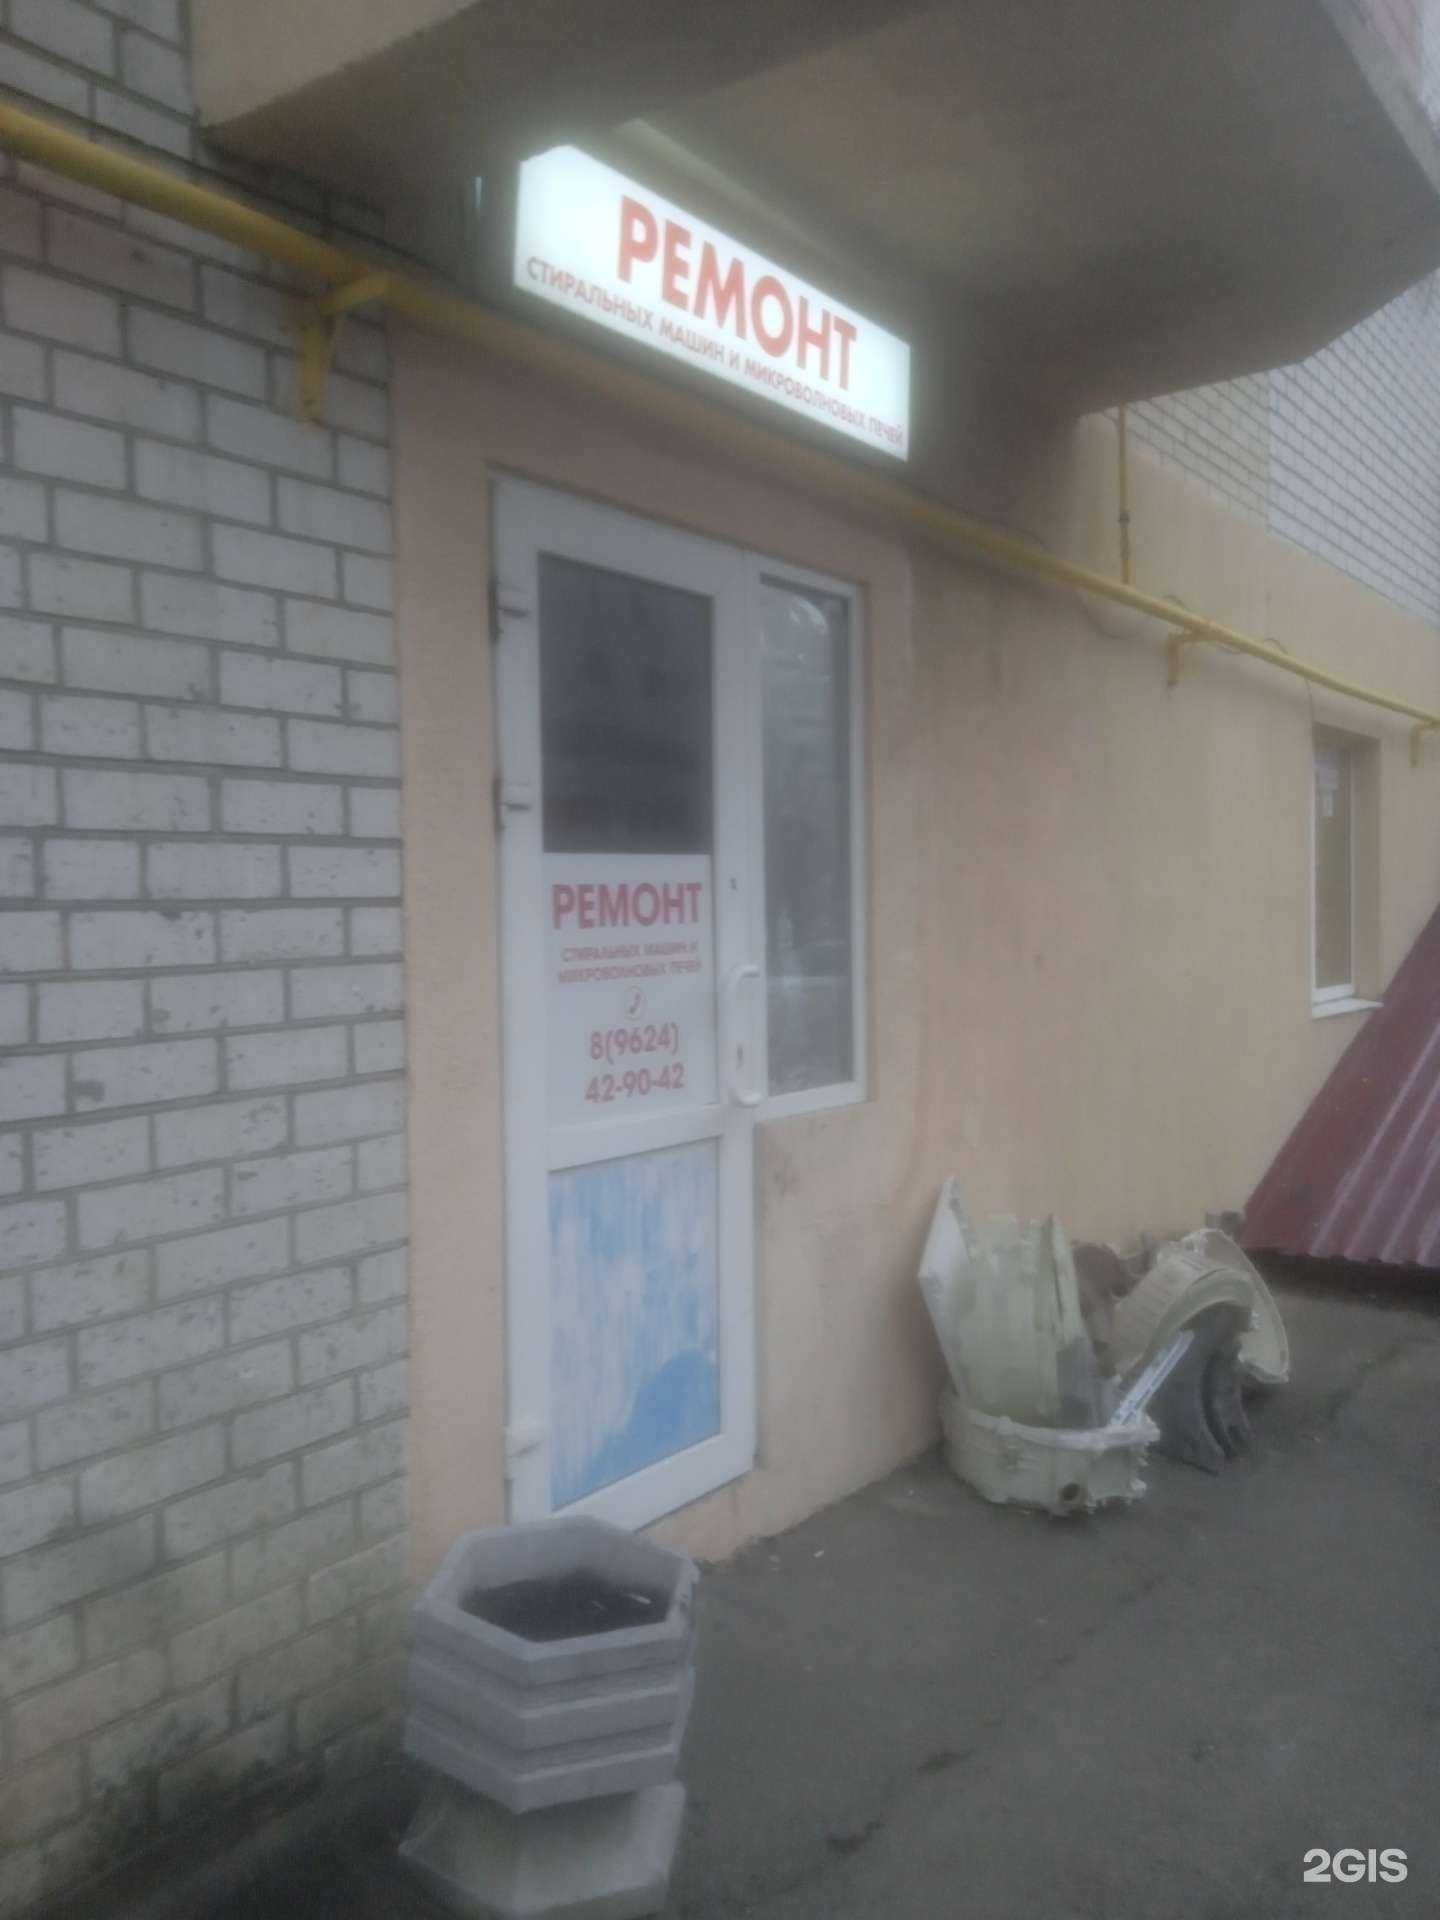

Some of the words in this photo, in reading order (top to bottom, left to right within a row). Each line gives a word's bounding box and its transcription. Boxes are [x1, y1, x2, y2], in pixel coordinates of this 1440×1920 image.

[617, 194, 857, 391] РЕМОНТ
[526, 256, 653, 332] СТИРАЛЬНЫХ
[659, 317, 725, 365] МАШИН
[728, 351, 741, 370] И
[744, 357, 867, 430] МИКРОВОЛНОВЫХ
[552, 882, 702, 930] РЕМОНТ
[590, 1022, 678, 1065] 8(9624)
[585, 1062, 685, 1103] 42-90-42
